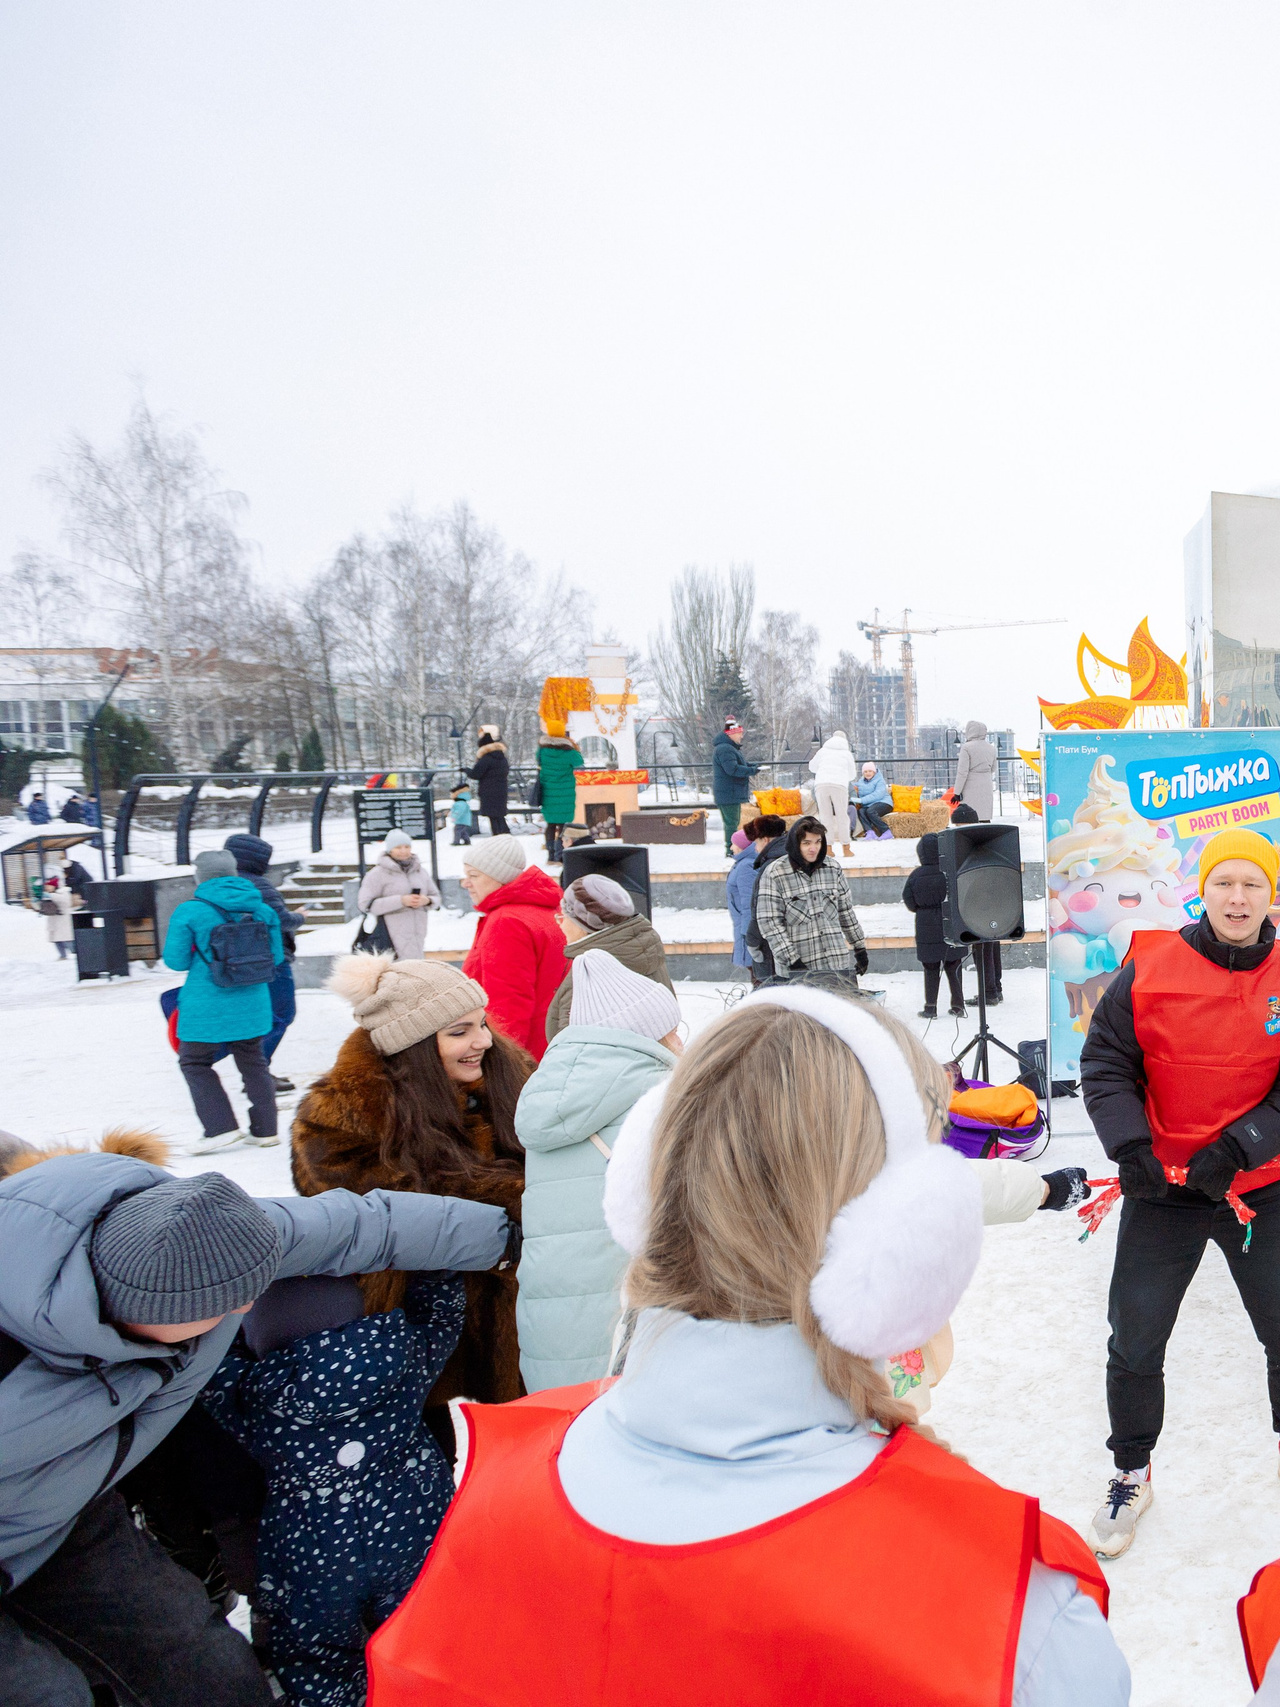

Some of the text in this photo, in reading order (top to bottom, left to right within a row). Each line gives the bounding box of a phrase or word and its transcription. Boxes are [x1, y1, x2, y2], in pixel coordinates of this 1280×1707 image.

[1081, 745, 1098, 755] Бум
[1189, 801, 1270, 832] PARTY BOOM
